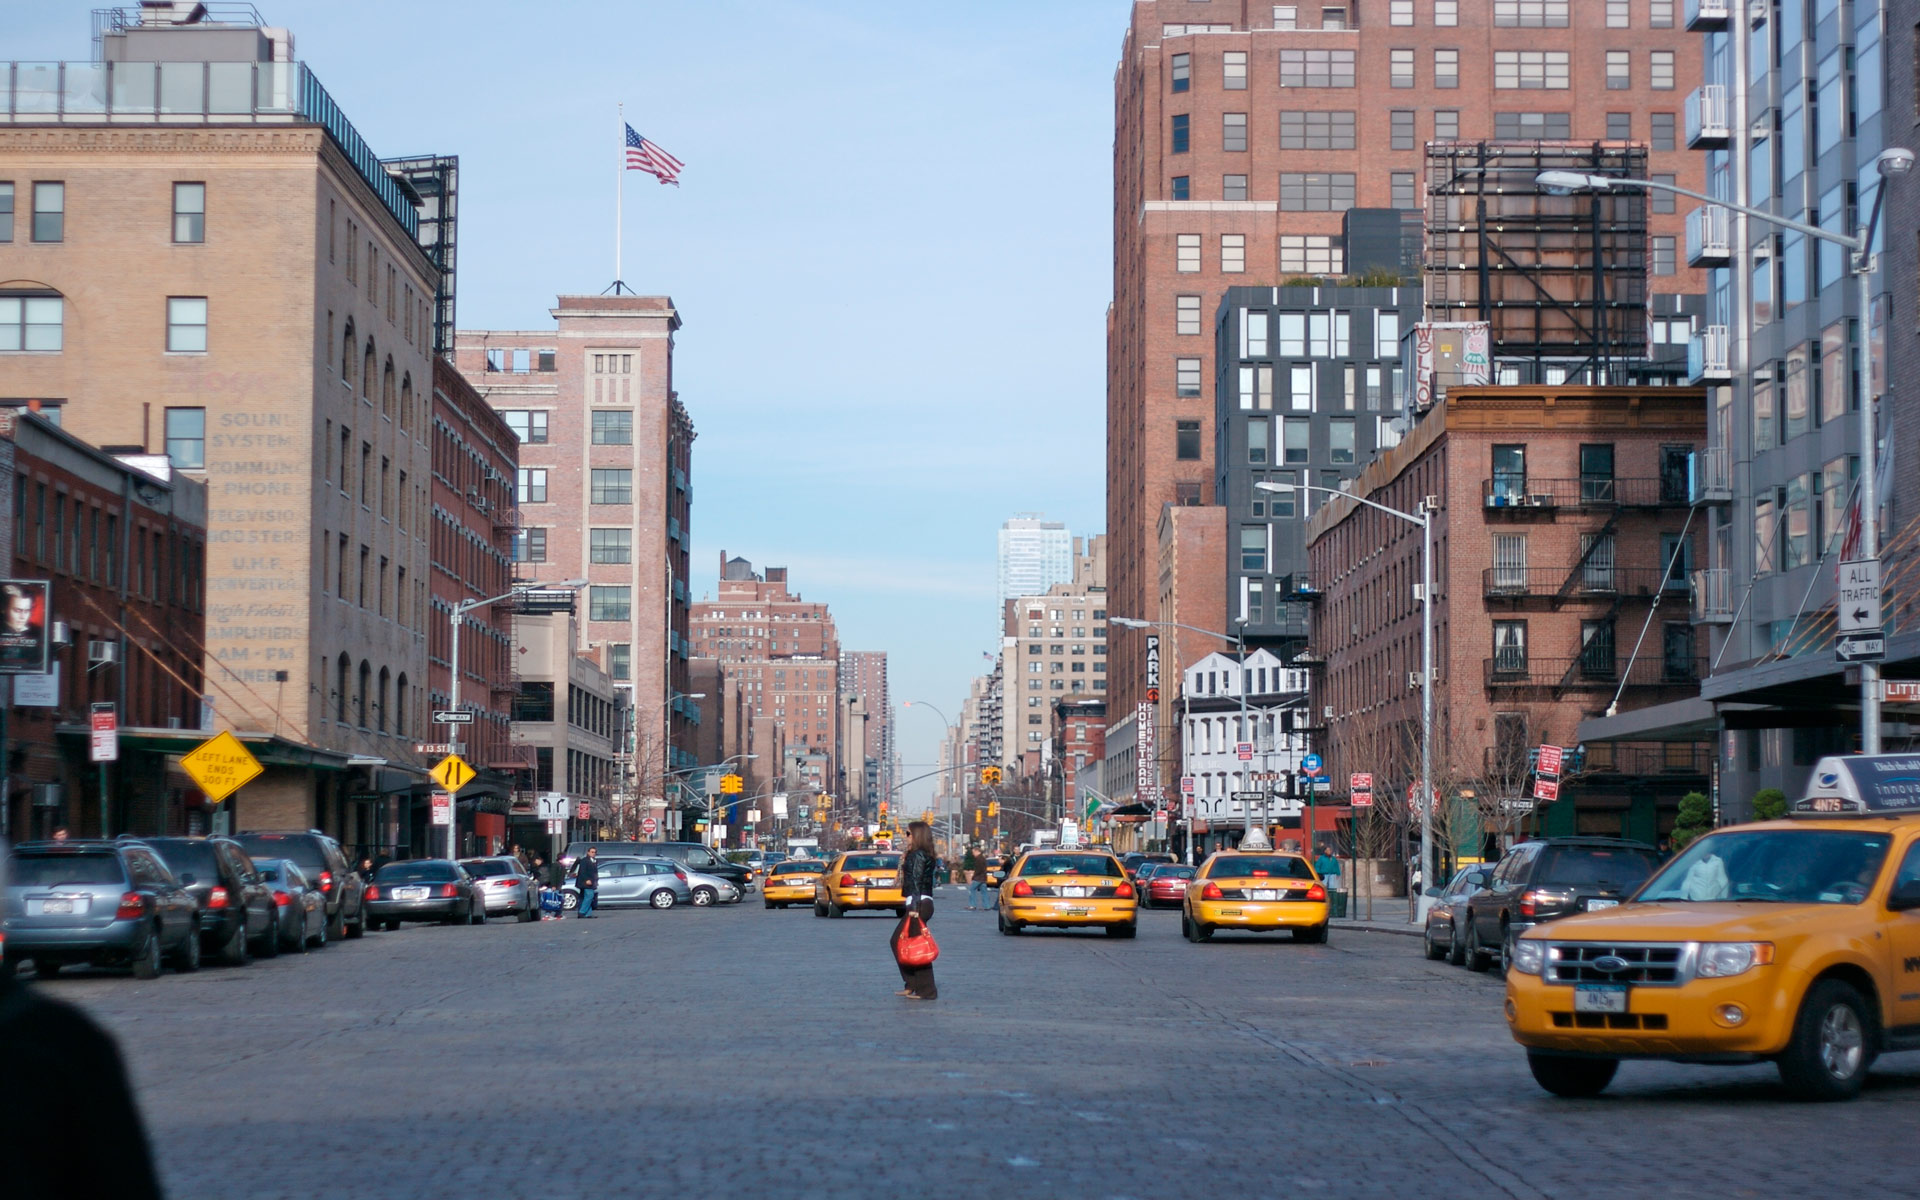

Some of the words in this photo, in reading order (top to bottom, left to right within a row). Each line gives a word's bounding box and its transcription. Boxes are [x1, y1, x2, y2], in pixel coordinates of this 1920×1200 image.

[1849, 567, 1872, 584] ALL
[1841, 587, 1879, 602] TRAFFIC
[1842, 642, 1856, 654] ONE
[1864, 641, 1880, 652] WAY
[1147, 637, 1159, 684] PARK
[1888, 683, 1920, 695] LITT
[1138, 703, 1147, 786] HOMESTEAD
[196, 752, 221, 762] LEFT
[222, 755, 249, 765] LANE
[207, 764, 235, 775] ENDS
[202, 775, 222, 785] 300
[224, 777, 237, 786] FT
[1813, 798, 1841, 812] 4N75
